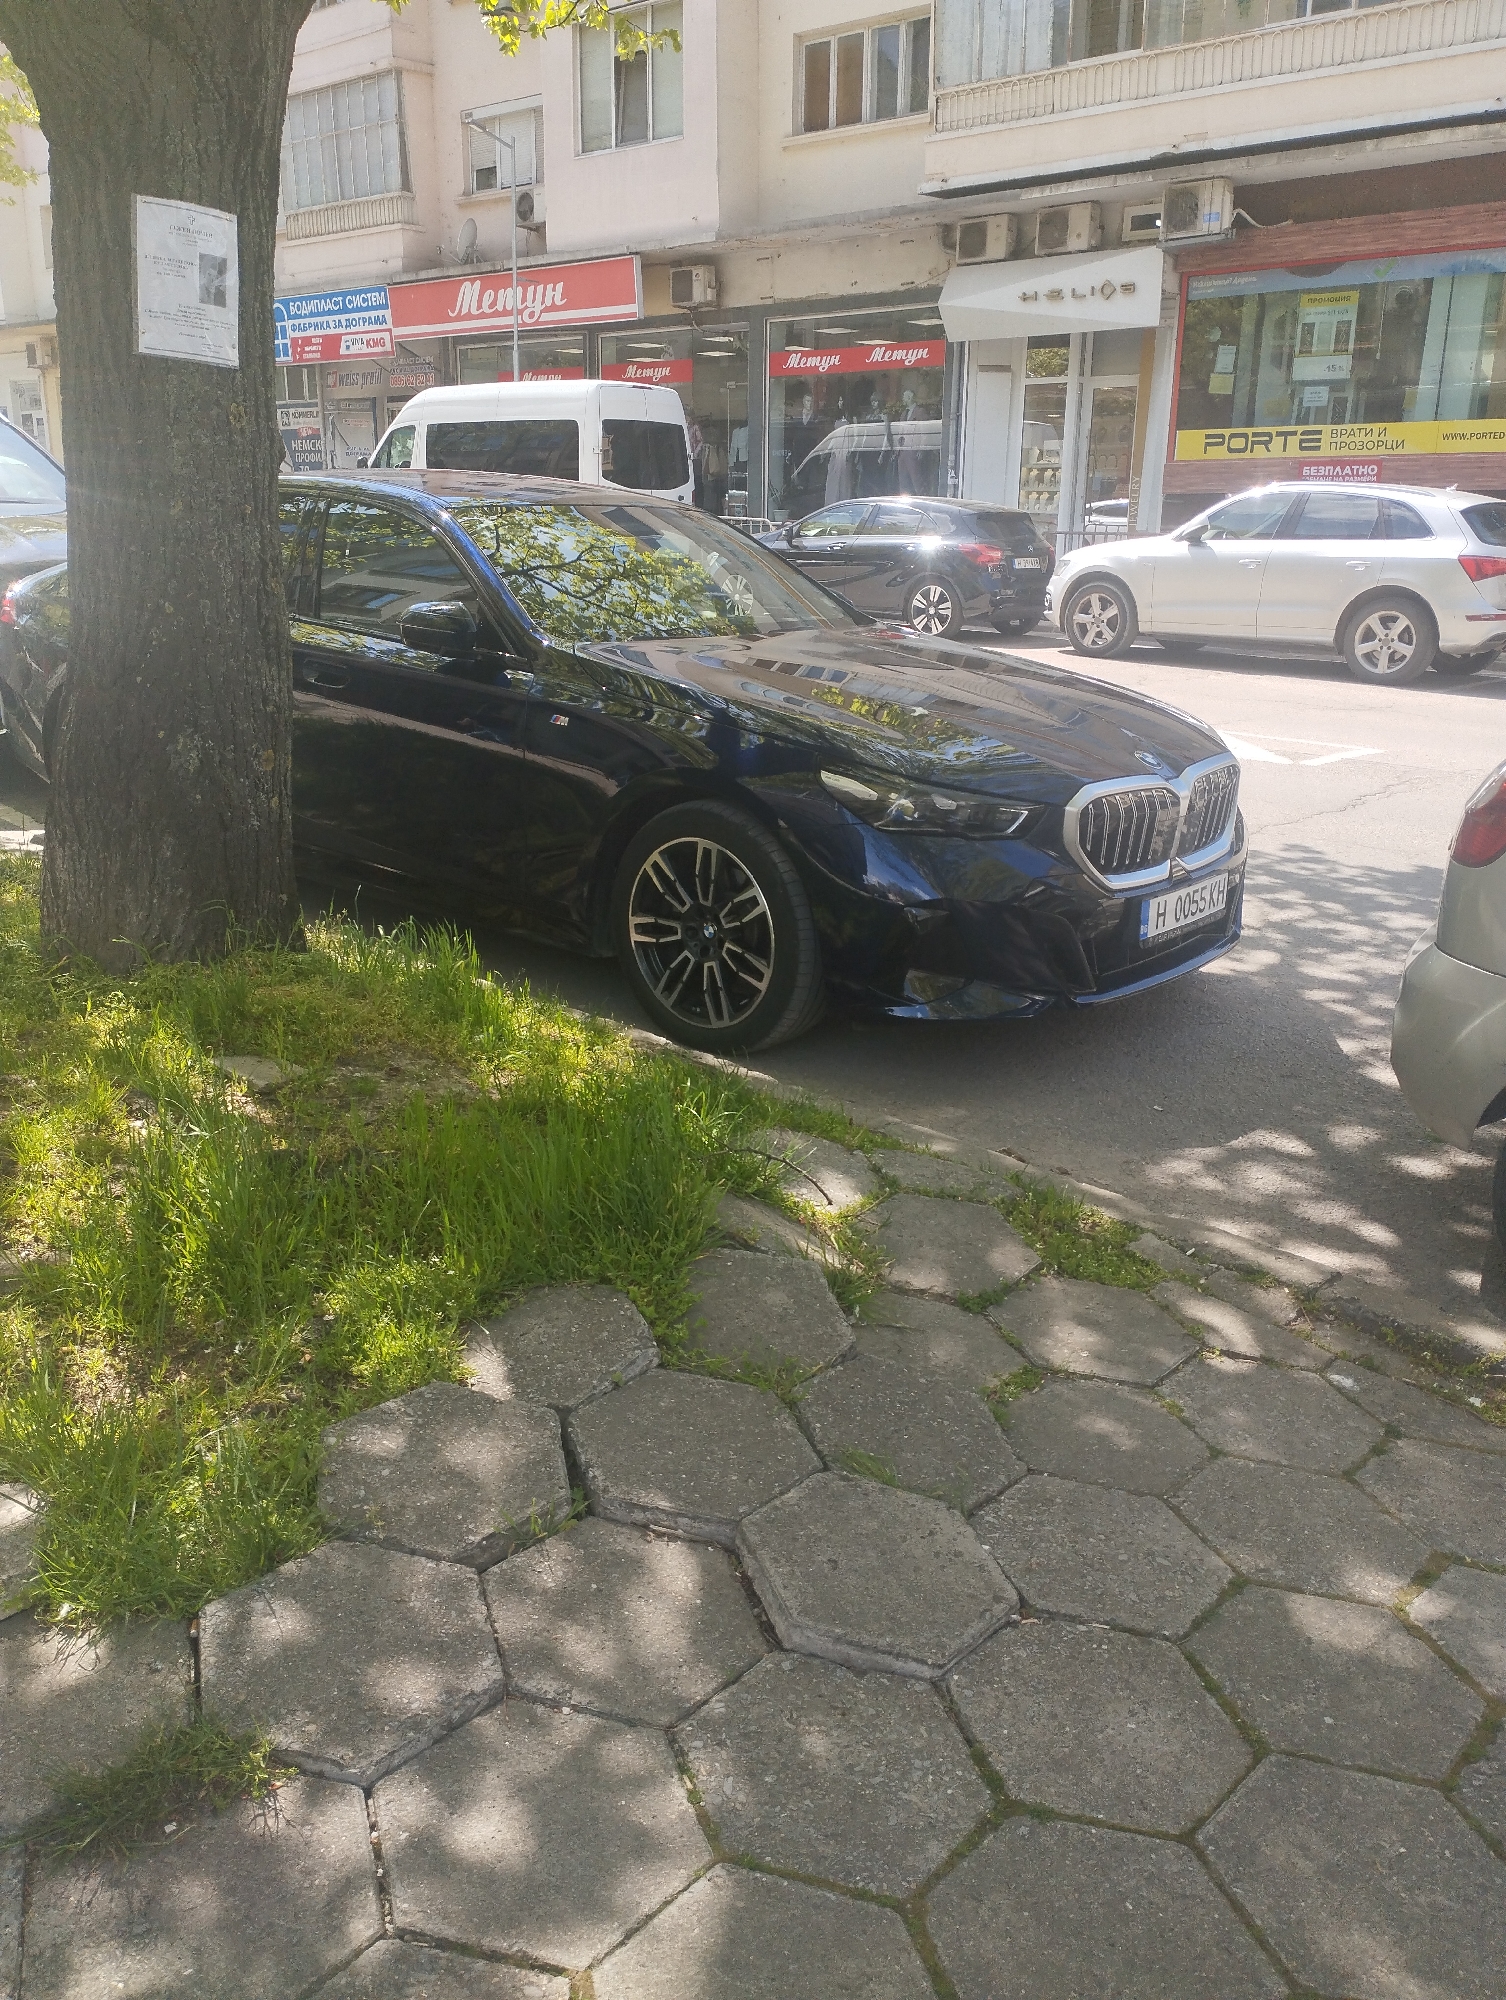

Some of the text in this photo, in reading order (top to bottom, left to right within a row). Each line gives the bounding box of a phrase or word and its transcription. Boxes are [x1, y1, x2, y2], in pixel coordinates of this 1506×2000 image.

[289, 291, 386, 316] БОДИПЛАСТ СИСТЕМ
[447, 279, 567, 324] Метун
[1307, 295, 1352, 304] ПРОМОЦИЯ
[290, 314, 387, 333] ФАБРИКА ЗА ДОГРАМА
[366, 337, 386, 349] KMG
[782, 346, 930, 372] Метун Метун
[338, 370, 360, 387] weiss
[621, 364, 672, 381] Метун
[1330, 426, 1388, 439] ВРАТИ И
[1203, 429, 1323, 454] PORTE
[1329, 438, 1405, 451] ПРОЗОРЦИ
[1302, 465, 1378, 476] БЕЗПЛАТНО
[1155, 900, 1167, 930] H
